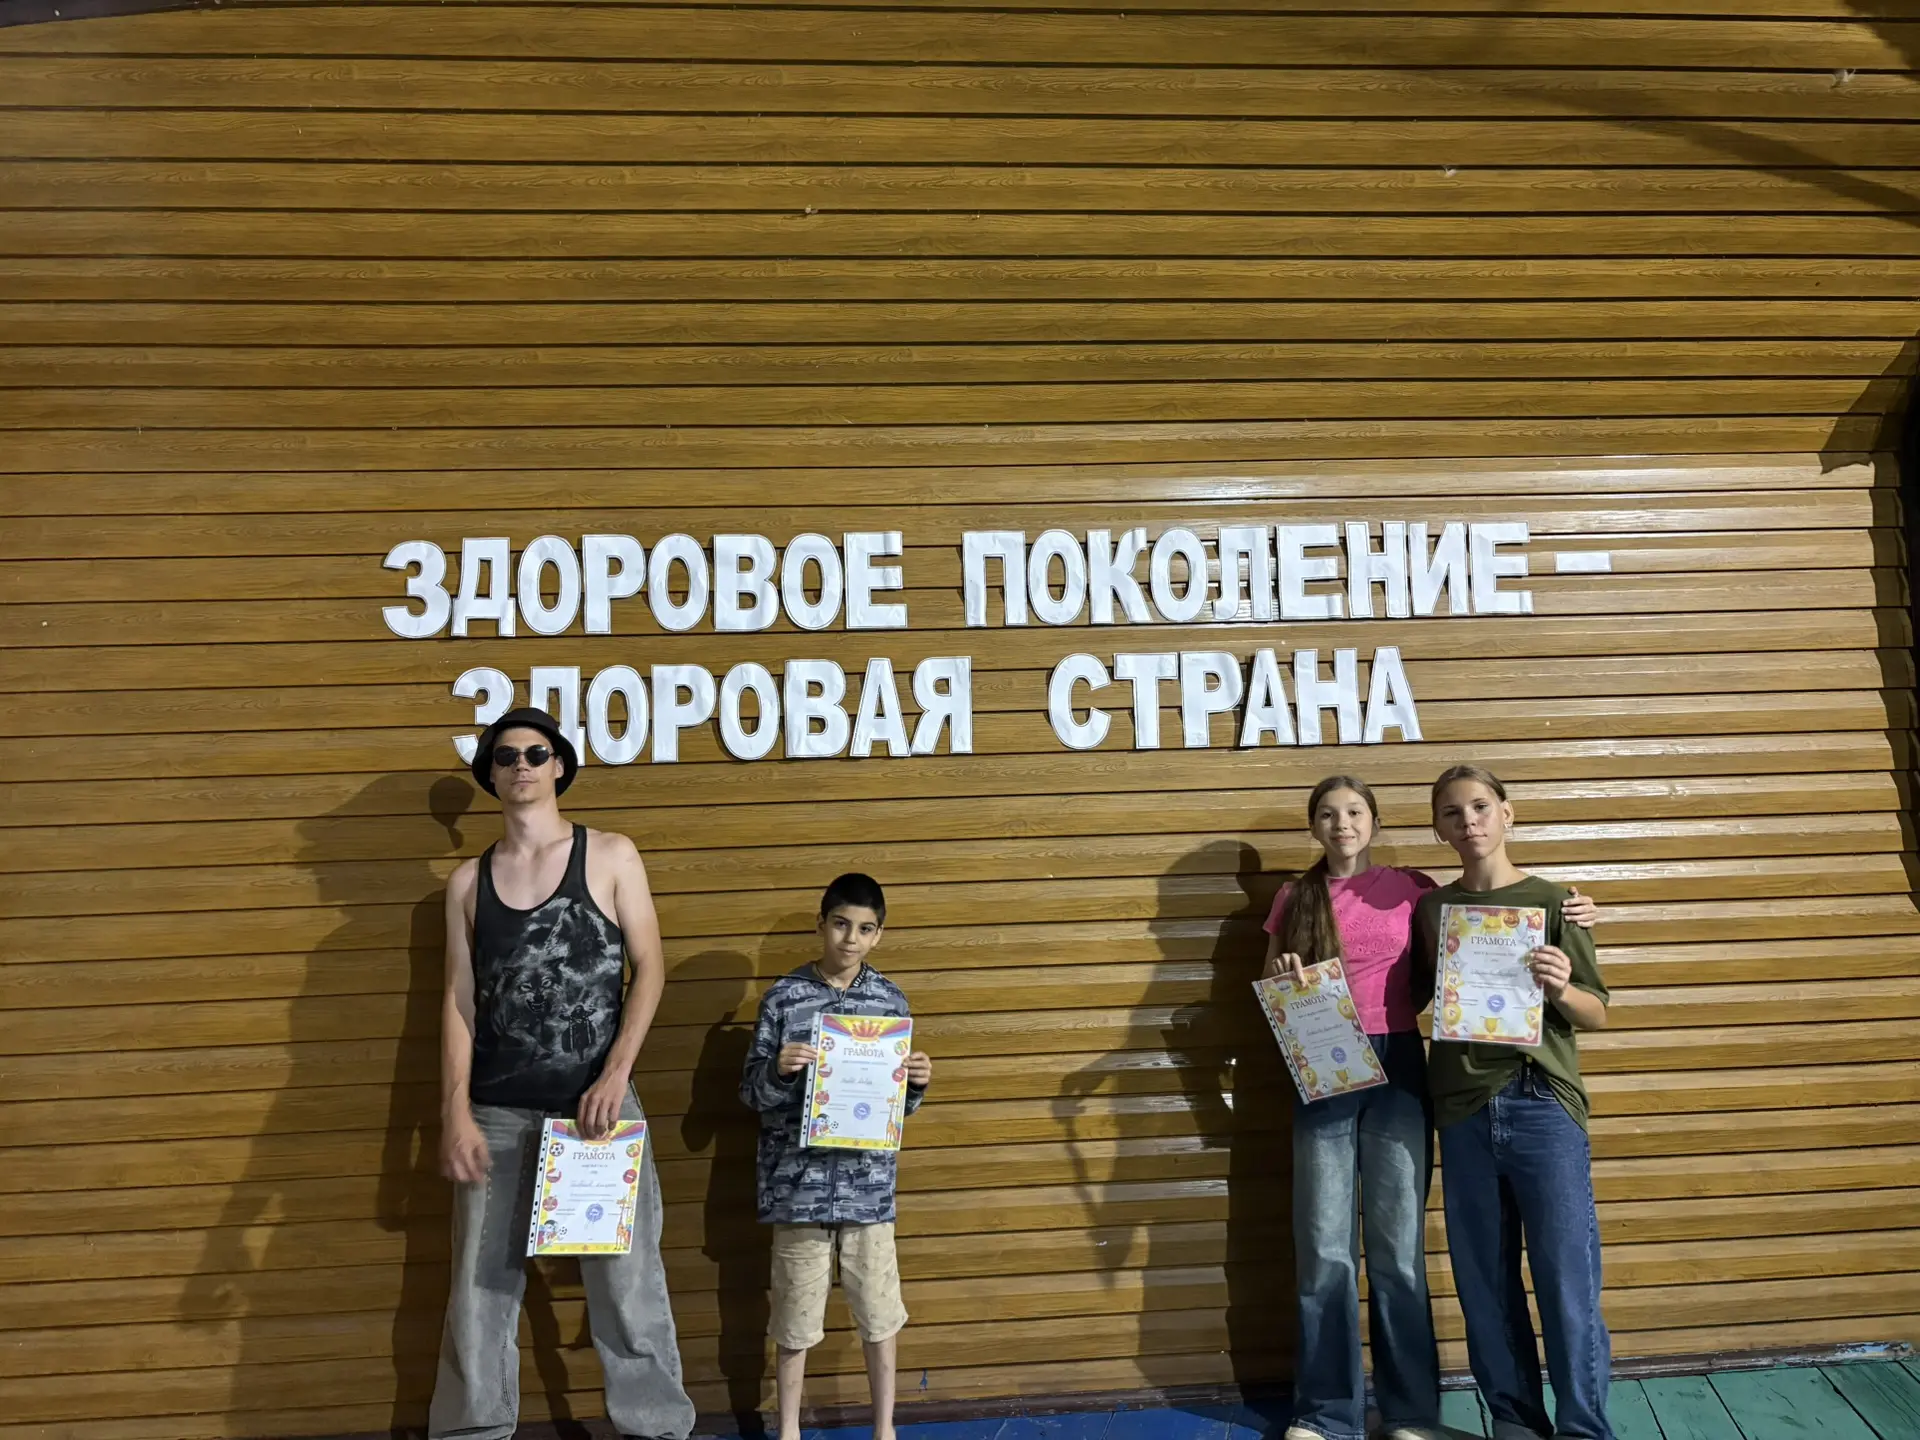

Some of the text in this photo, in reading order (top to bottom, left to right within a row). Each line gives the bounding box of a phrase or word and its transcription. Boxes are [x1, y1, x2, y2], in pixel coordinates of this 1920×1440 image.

[382, 531, 908, 638] ЗДОРОВОЕ
[1048, 646, 1423, 749] СТРАНА
[1471, 935, 1517, 947] ГРАМОТА
[1290, 994, 1328, 1011] ГРАМОТА
[843, 1047, 885, 1058] ГРАМОТА
[572, 1151, 616, 1161] ГРАМОТА
